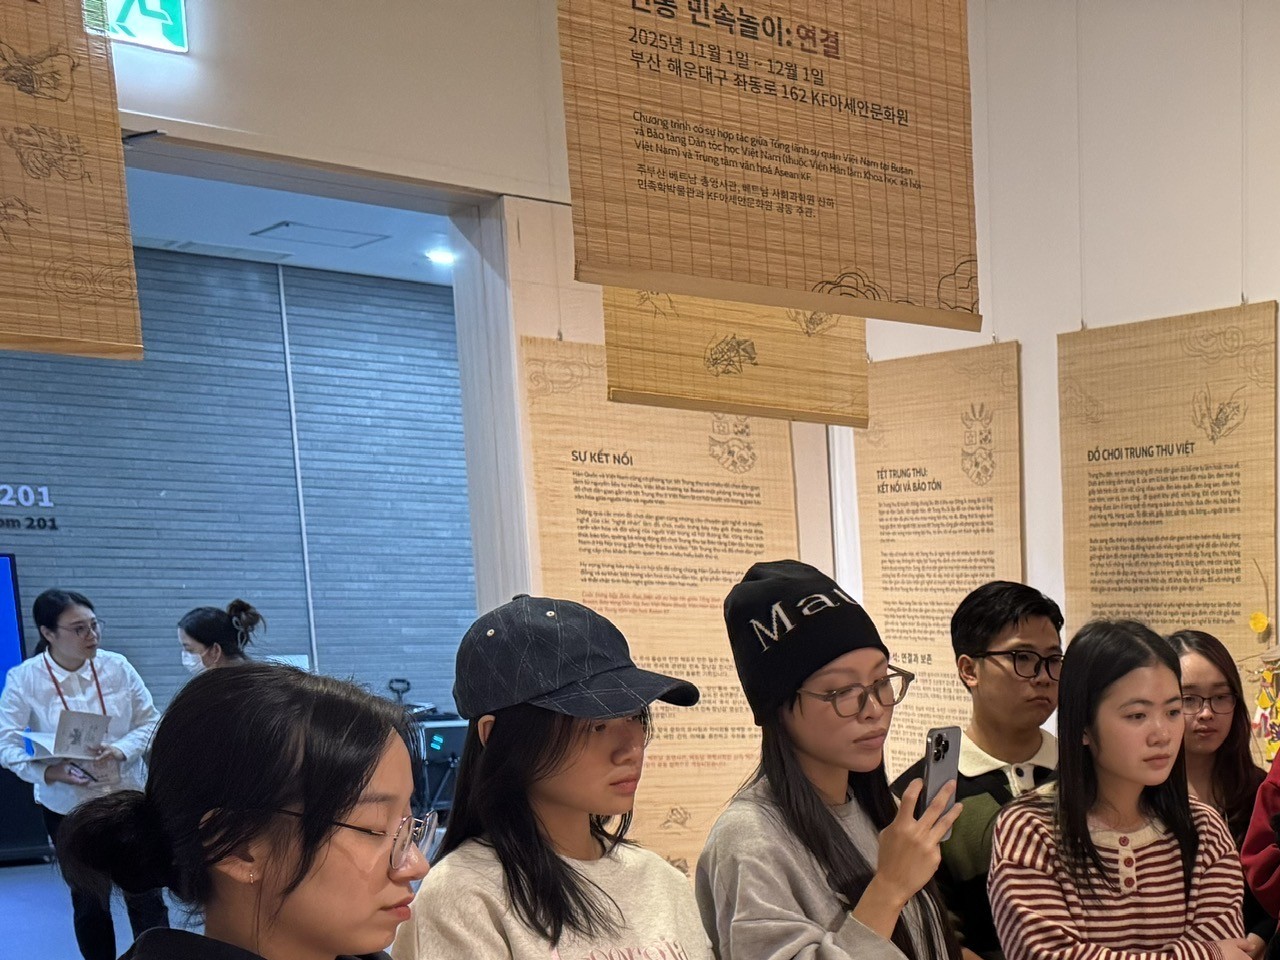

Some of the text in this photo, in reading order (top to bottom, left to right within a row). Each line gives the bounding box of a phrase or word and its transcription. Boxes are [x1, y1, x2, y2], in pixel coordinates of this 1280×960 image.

[628, 26, 683, 55] 2025년
[688, 40, 721, 63] 11월
[726, 50, 749, 70] 1일
[767, 59, 797, 80] 12월
[803, 67, 824, 87] 1일
[630, 49, 909, 128] 부산 해운대구 좌동로 162 KF아세안문화원
[572, 449, 633, 466] SỰ KẾT NỐI
[1087, 440, 1195, 462] ĐỒ CHƠI TRUNG THU VIỆT
[876, 467, 928, 480] TẾT TRUNG THU:
[878, 478, 942, 494] KẾT NỐI VÀ BẢO TỒN
[0, 485, 54, 507] 201
[25, 517, 59, 530] 201
